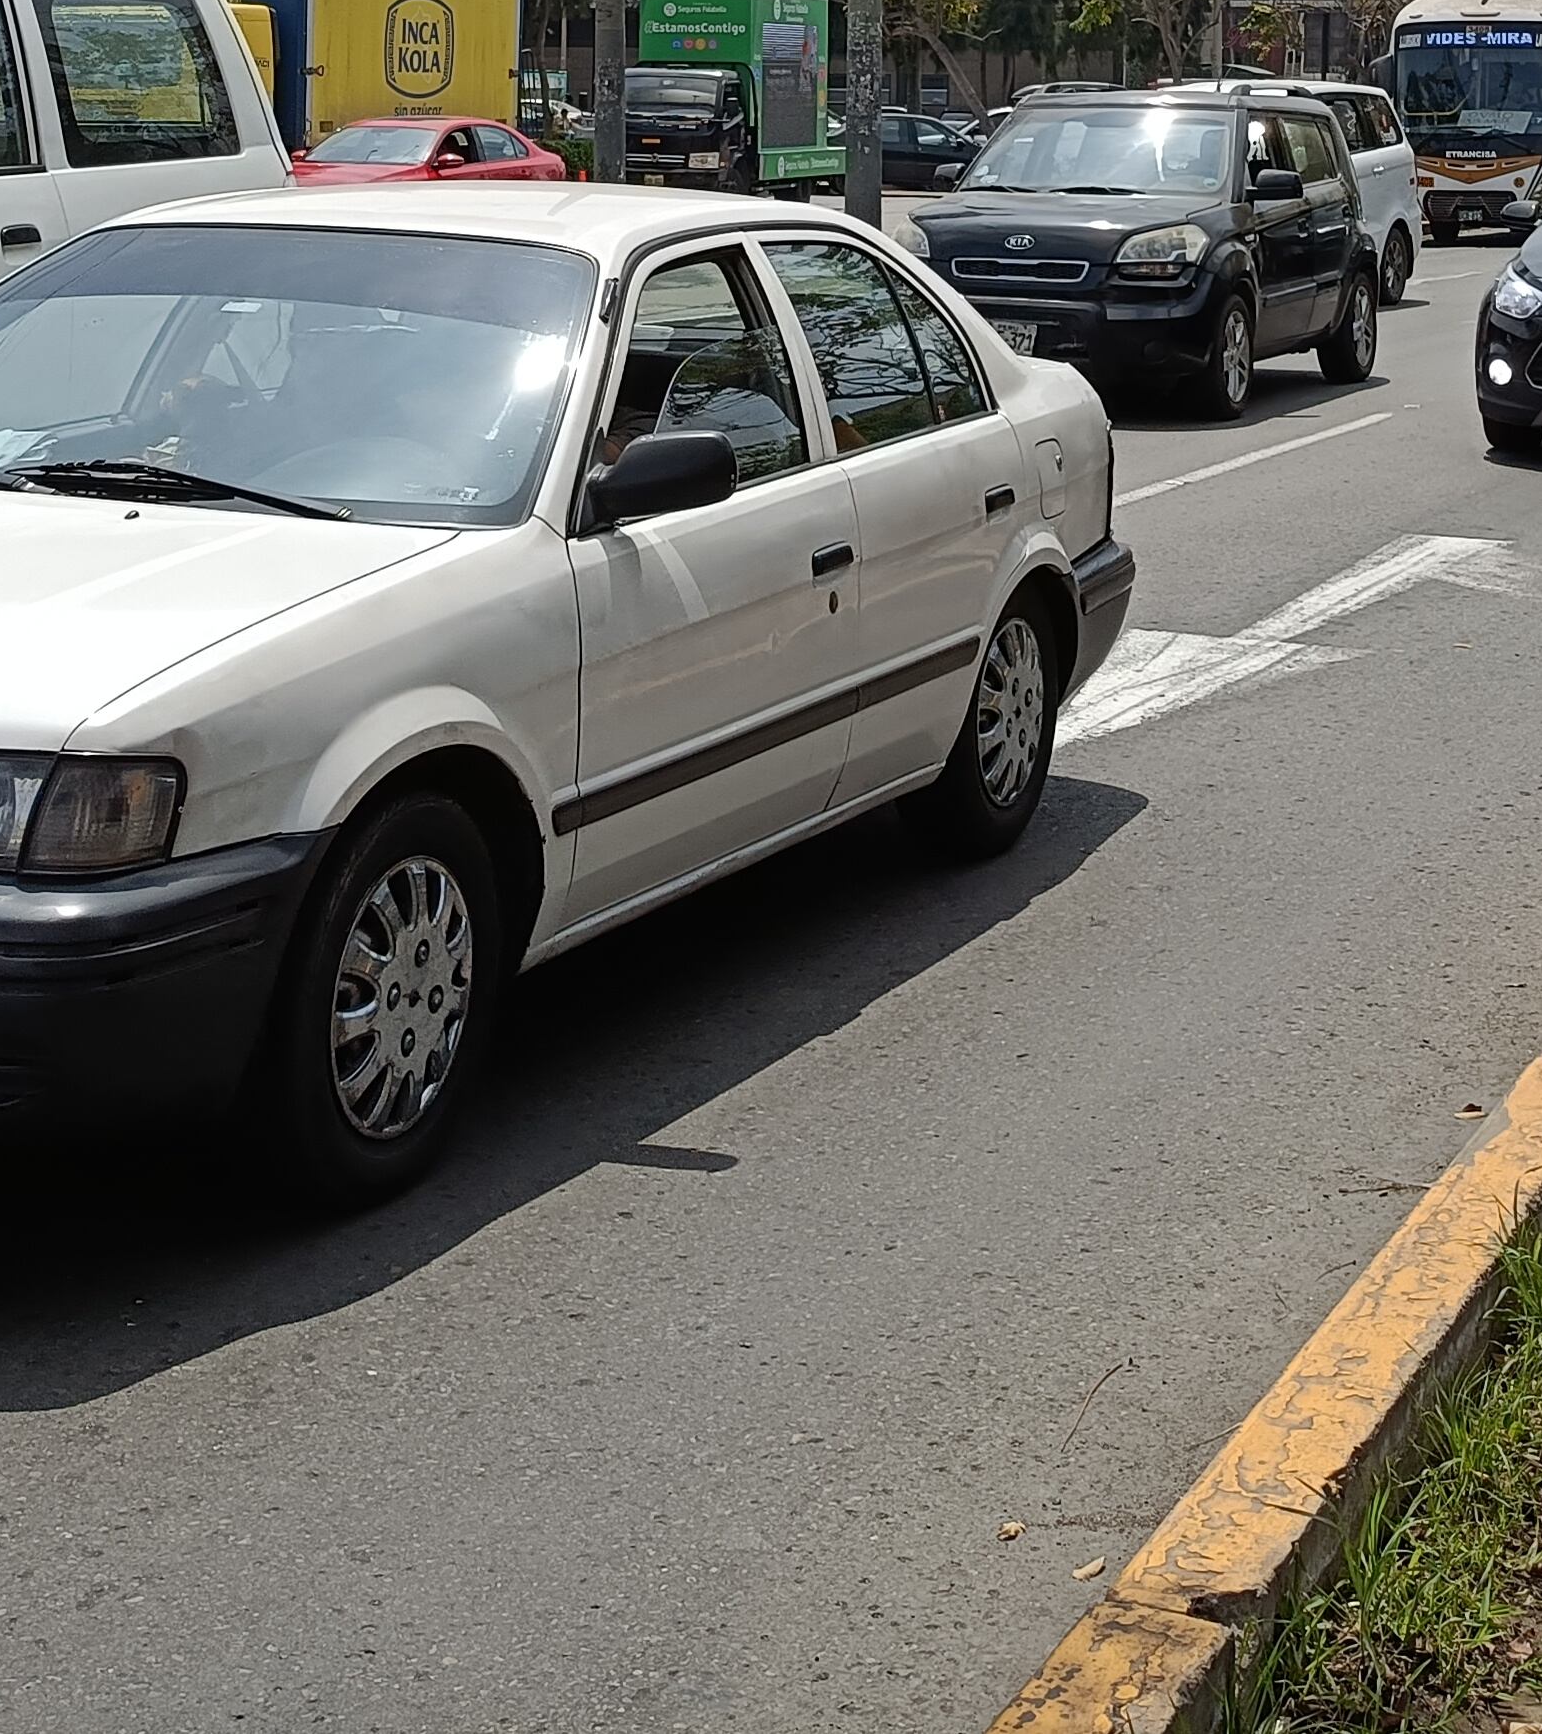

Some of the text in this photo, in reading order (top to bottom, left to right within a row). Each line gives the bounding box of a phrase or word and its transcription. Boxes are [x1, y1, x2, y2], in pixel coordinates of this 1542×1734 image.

[401, 18, 440, 45] INCA
[644, 21, 746, 36] #EstamosContigo
[1426, 32, 1477, 45] VIDES
[398, 47, 441, 73] KOLA
[394, 102, 443, 116] sin azúcar
[1445, 150, 1497, 158] ETRANCISA
[1009, 237, 1030, 247] KIA
